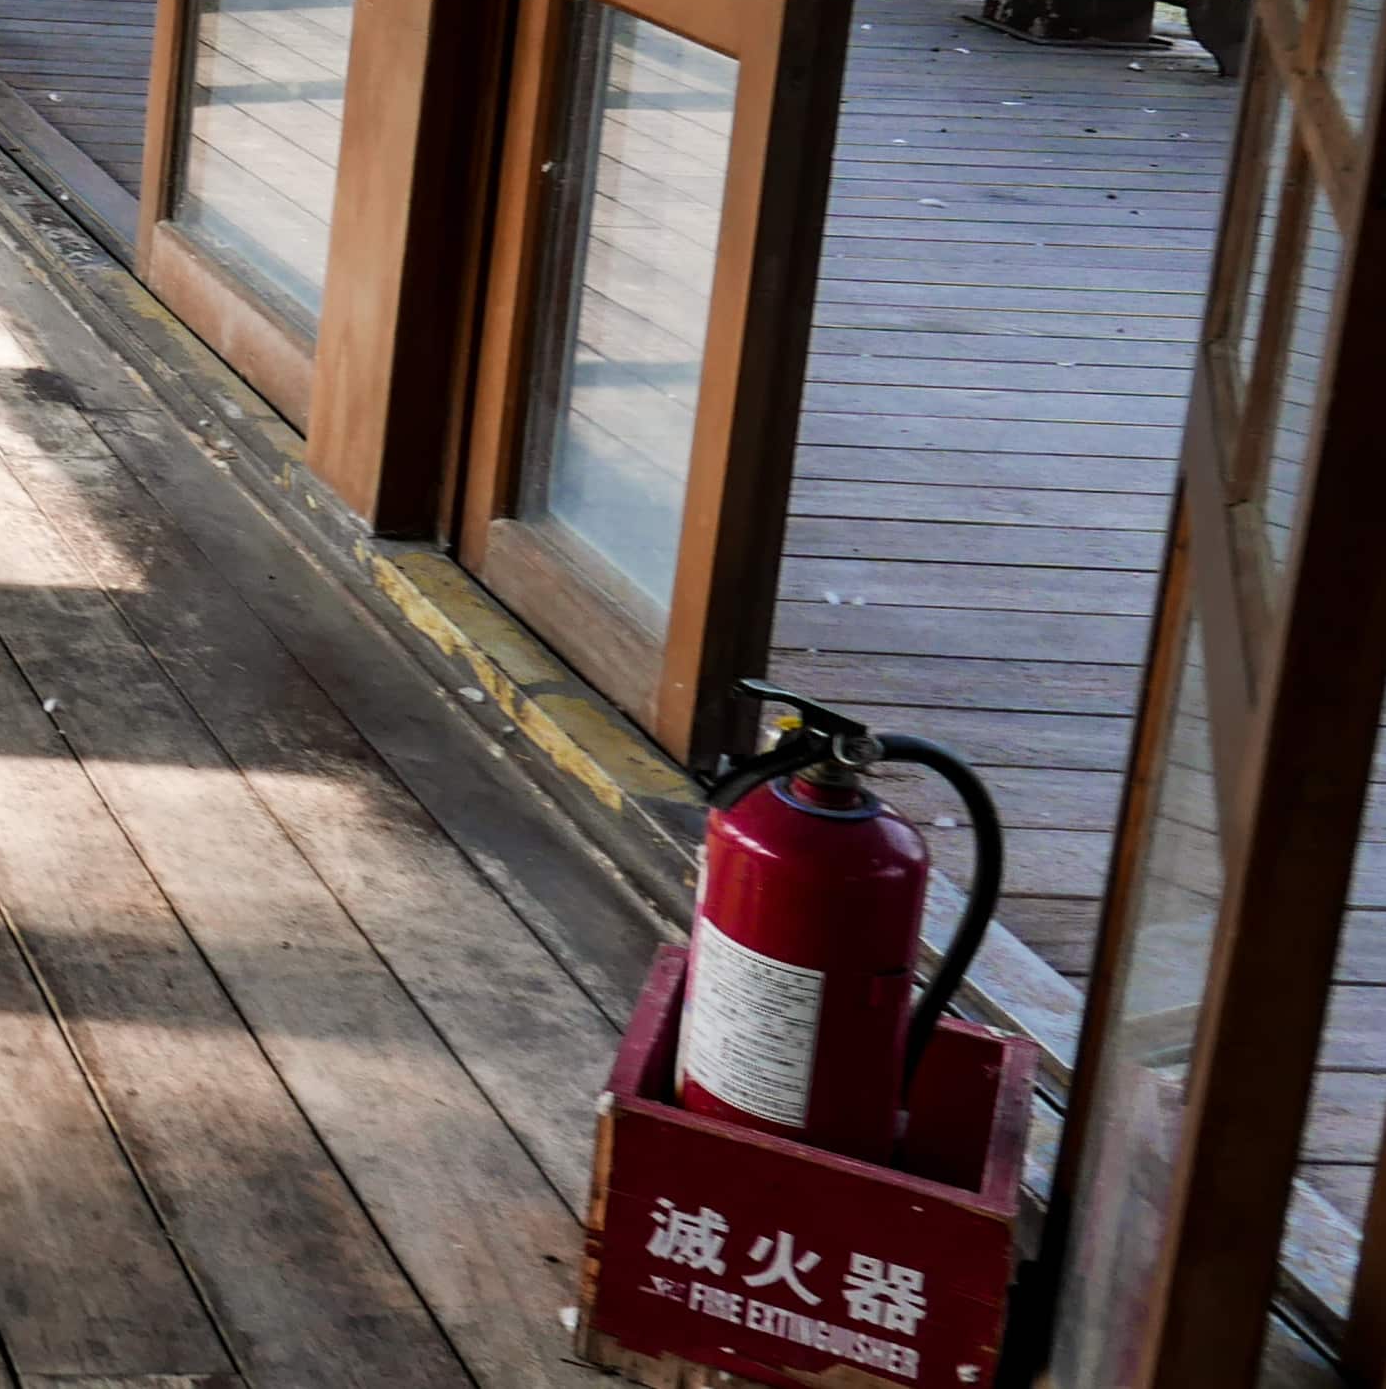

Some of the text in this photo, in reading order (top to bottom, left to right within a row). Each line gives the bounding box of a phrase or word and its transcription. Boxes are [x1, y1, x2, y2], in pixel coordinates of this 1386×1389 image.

[646, 1198, 927, 1335] 滅火器
[690, 1282, 742, 1324] FIRE
